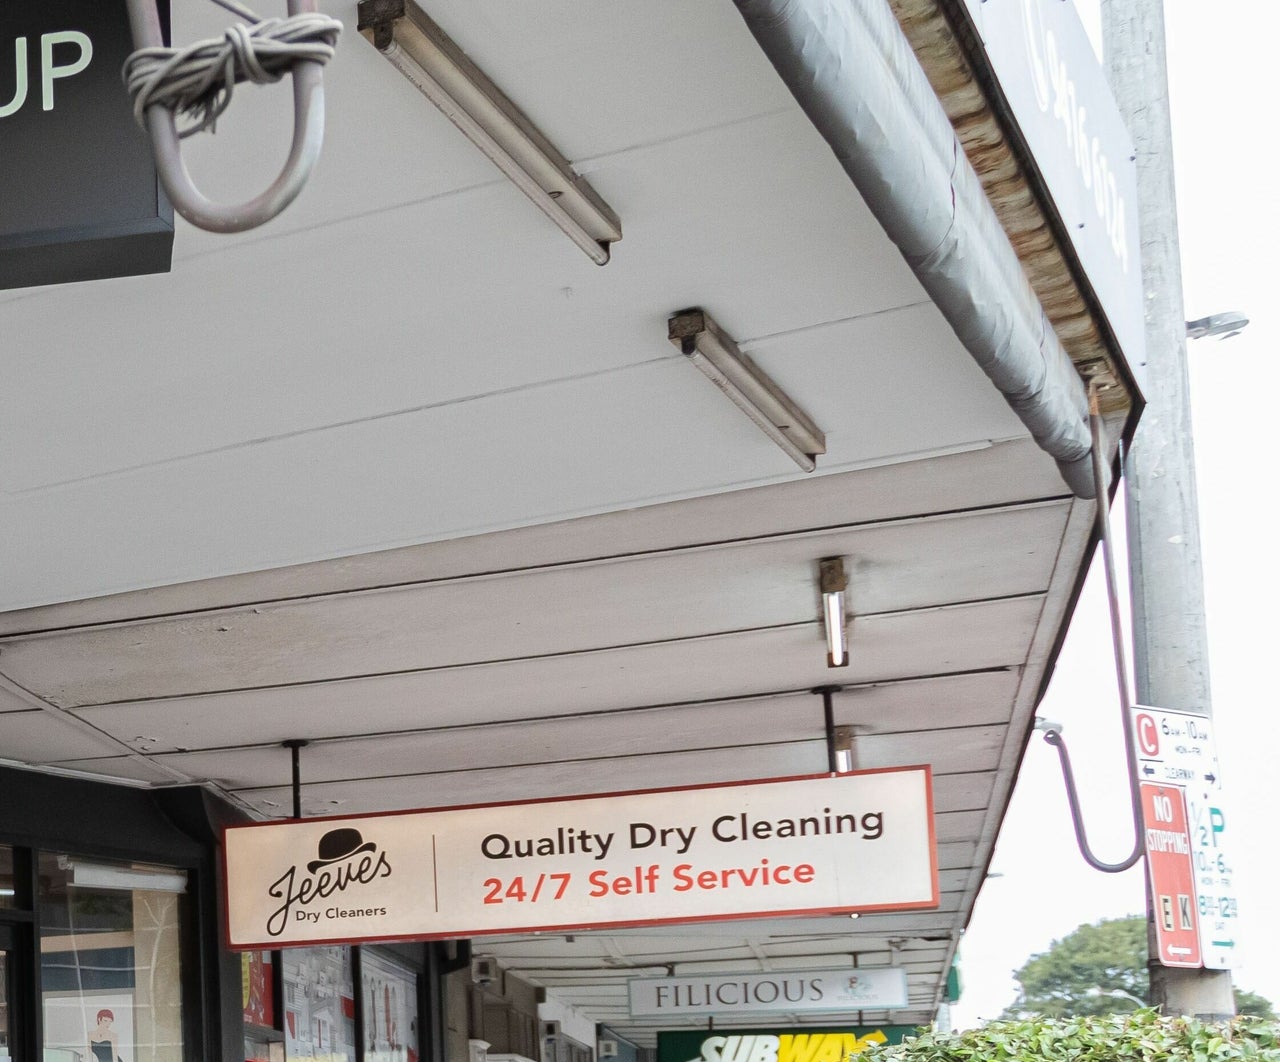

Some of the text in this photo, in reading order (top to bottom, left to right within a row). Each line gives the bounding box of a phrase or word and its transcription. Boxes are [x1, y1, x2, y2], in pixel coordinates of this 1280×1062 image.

[1140, 717, 1156, 752] C
[1152, 795, 1173, 822] NO
[481, 807, 885, 861] Quality Dry Cleaning
[1147, 828, 1189, 855] STOPPING
[266, 851, 392, 936] Jeeves
[483, 858, 816, 905] 24/7 Self Service
[296, 904, 387, 925] Dry Cleaners
[655, 978, 824, 1008] FILICIOUS
